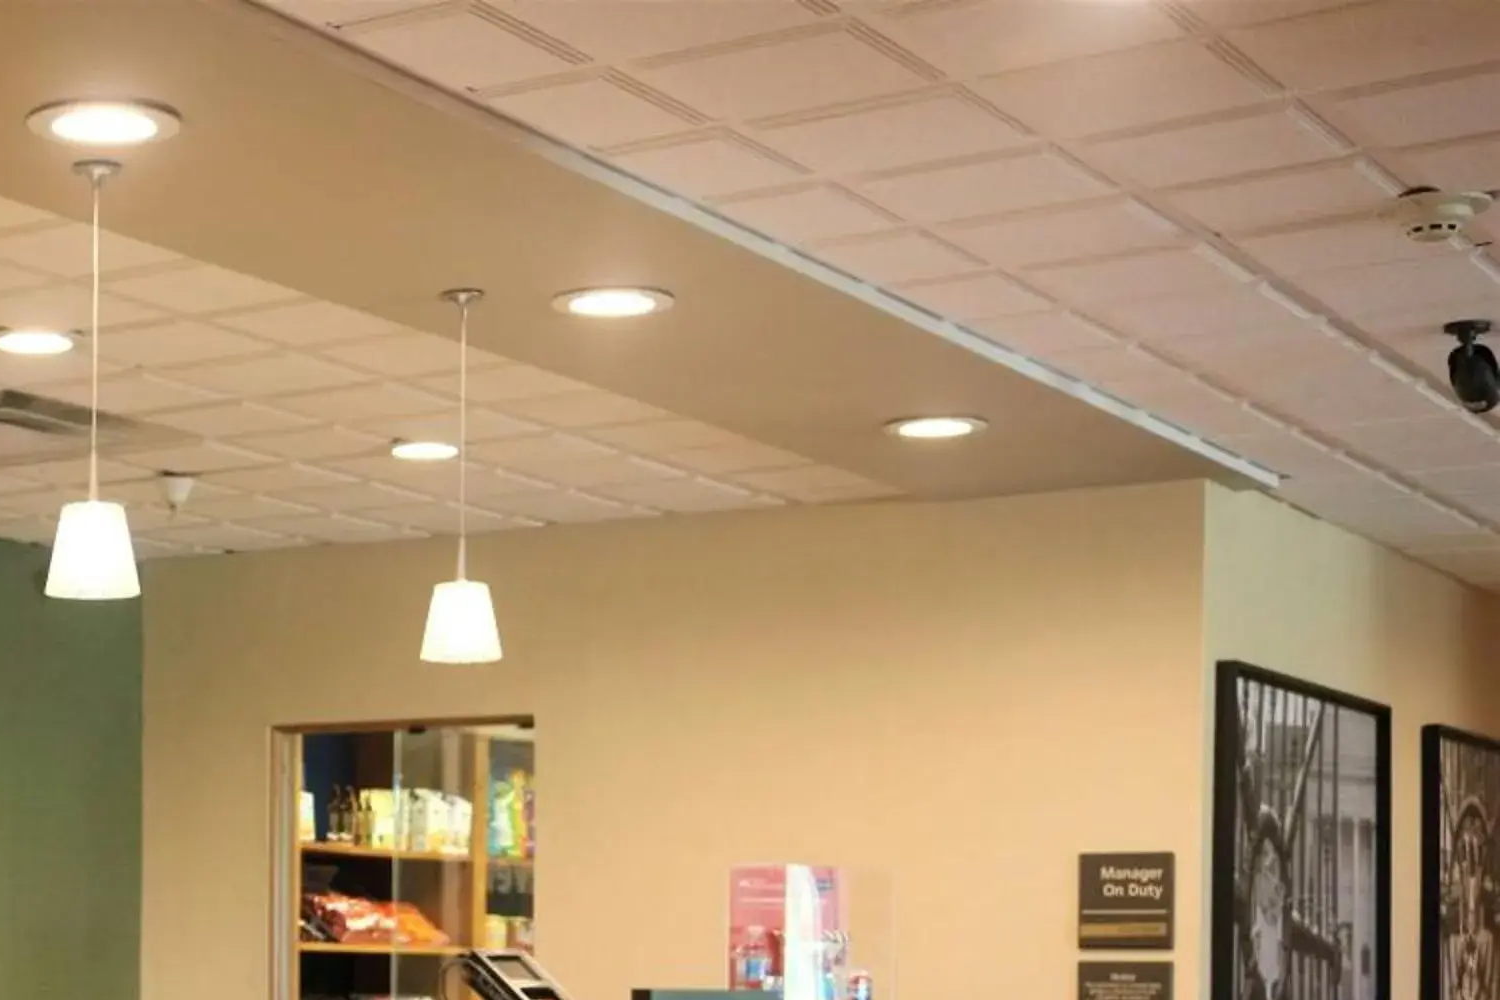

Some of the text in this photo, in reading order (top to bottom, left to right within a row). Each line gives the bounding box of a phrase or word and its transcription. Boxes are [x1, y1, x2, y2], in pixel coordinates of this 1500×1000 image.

[1100, 866, 1163, 882] Manager
[1103, 883, 1164, 900] On Duty
